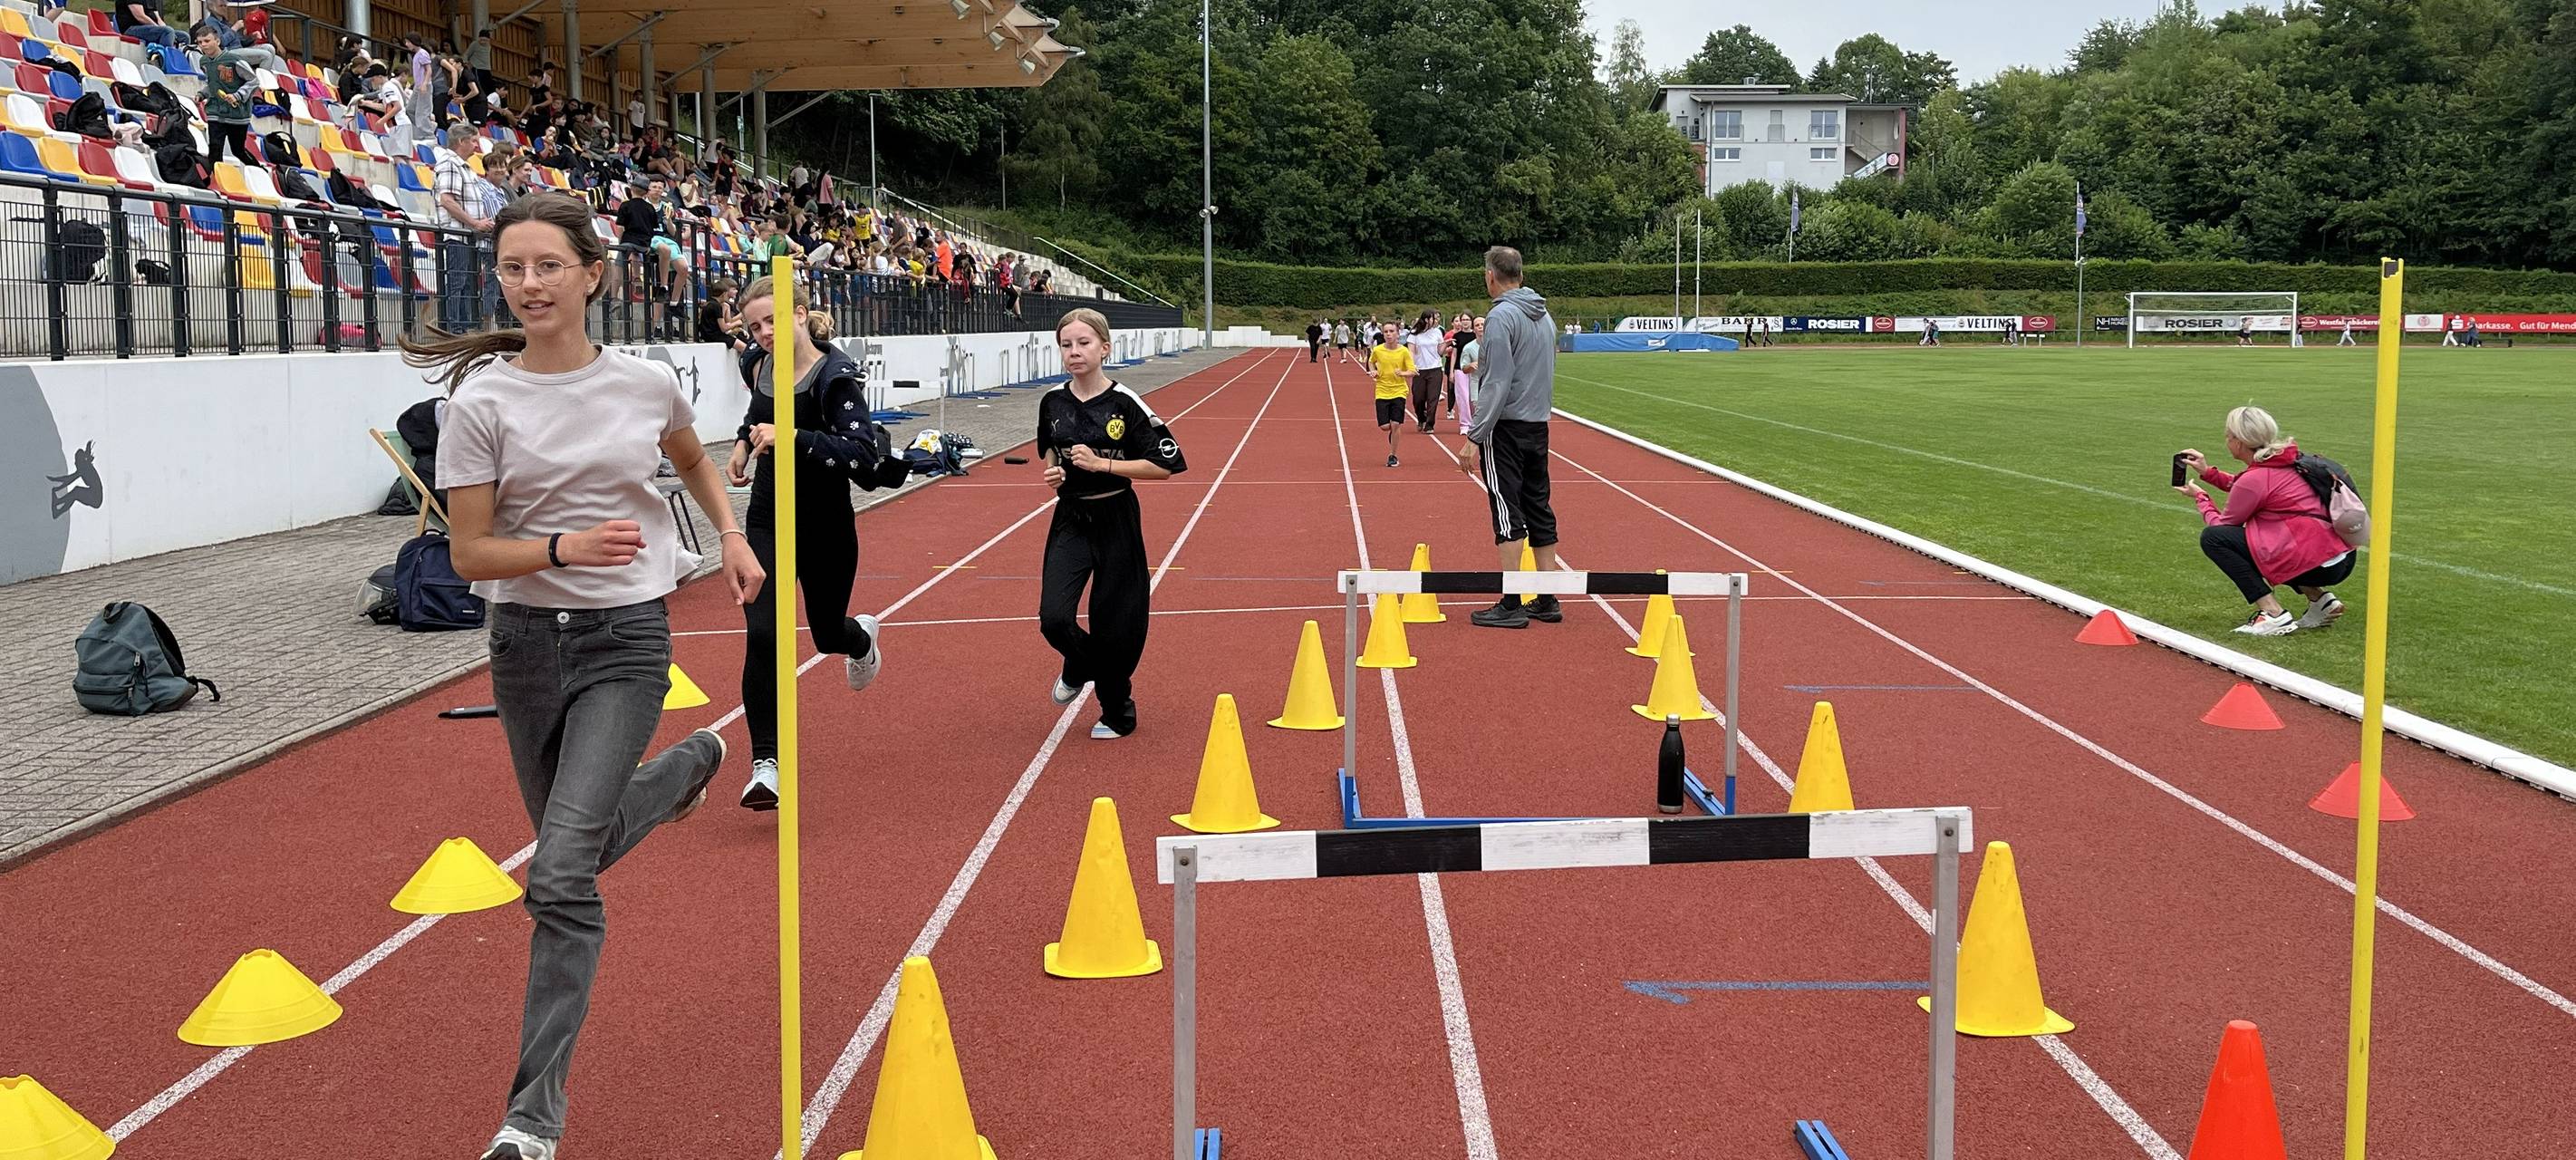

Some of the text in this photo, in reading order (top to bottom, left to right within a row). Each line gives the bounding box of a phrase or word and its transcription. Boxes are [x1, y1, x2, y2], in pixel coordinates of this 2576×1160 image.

[1636, 319, 1674, 329] VELTINS
[1808, 319, 1859, 329] ROSIER
[2165, 319, 2223, 328] ROSIER
[2519, 322, 2535, 330] Gut
[2536, 321, 2551, 330] für
